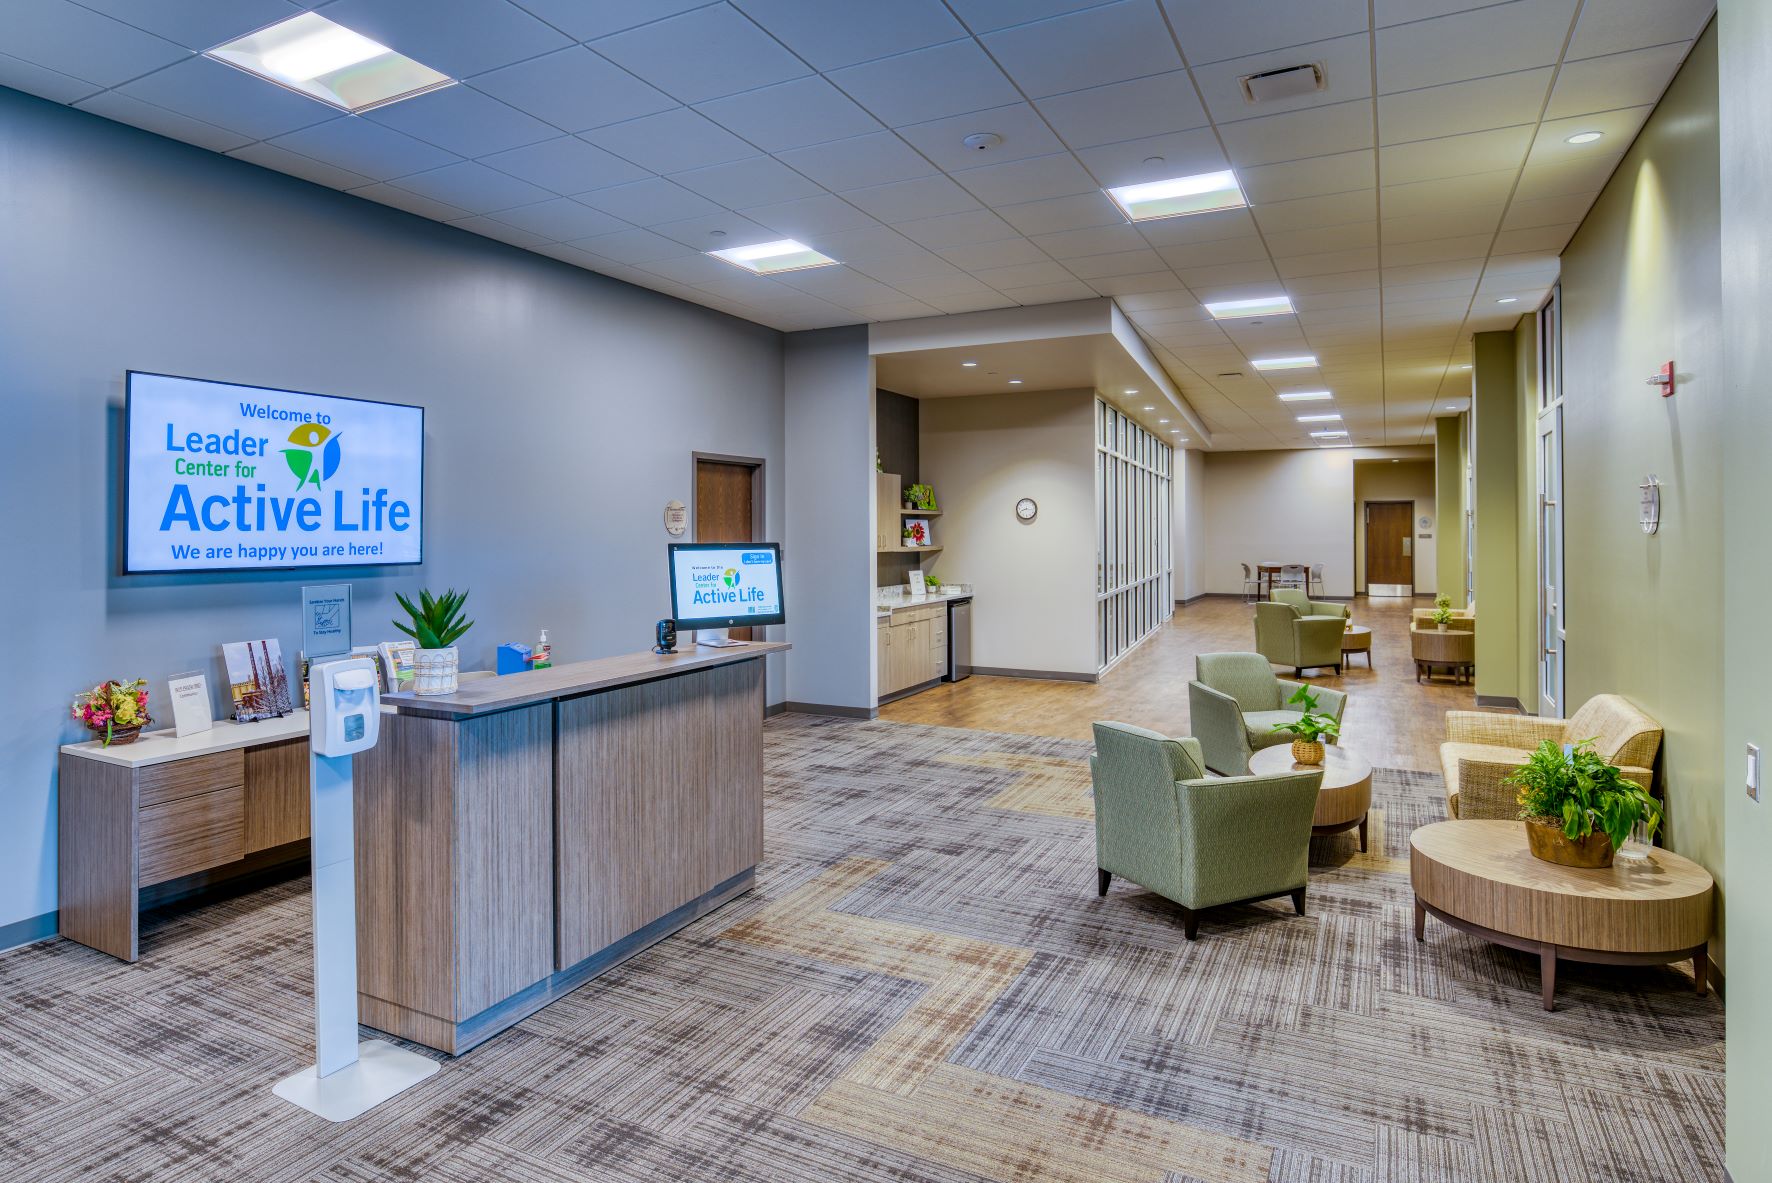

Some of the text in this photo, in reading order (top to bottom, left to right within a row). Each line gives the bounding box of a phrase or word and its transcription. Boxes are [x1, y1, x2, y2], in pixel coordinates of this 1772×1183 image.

[240, 402, 331, 424] Welcome to
[166, 423, 268, 456] Leader
[176, 458, 256, 478] Center for
[160, 483, 410, 531] Active Life
[171, 542, 383, 561] We are happy you are here!
[692, 572, 720, 582] Leader
[693, 587, 765, 604] Active Life
